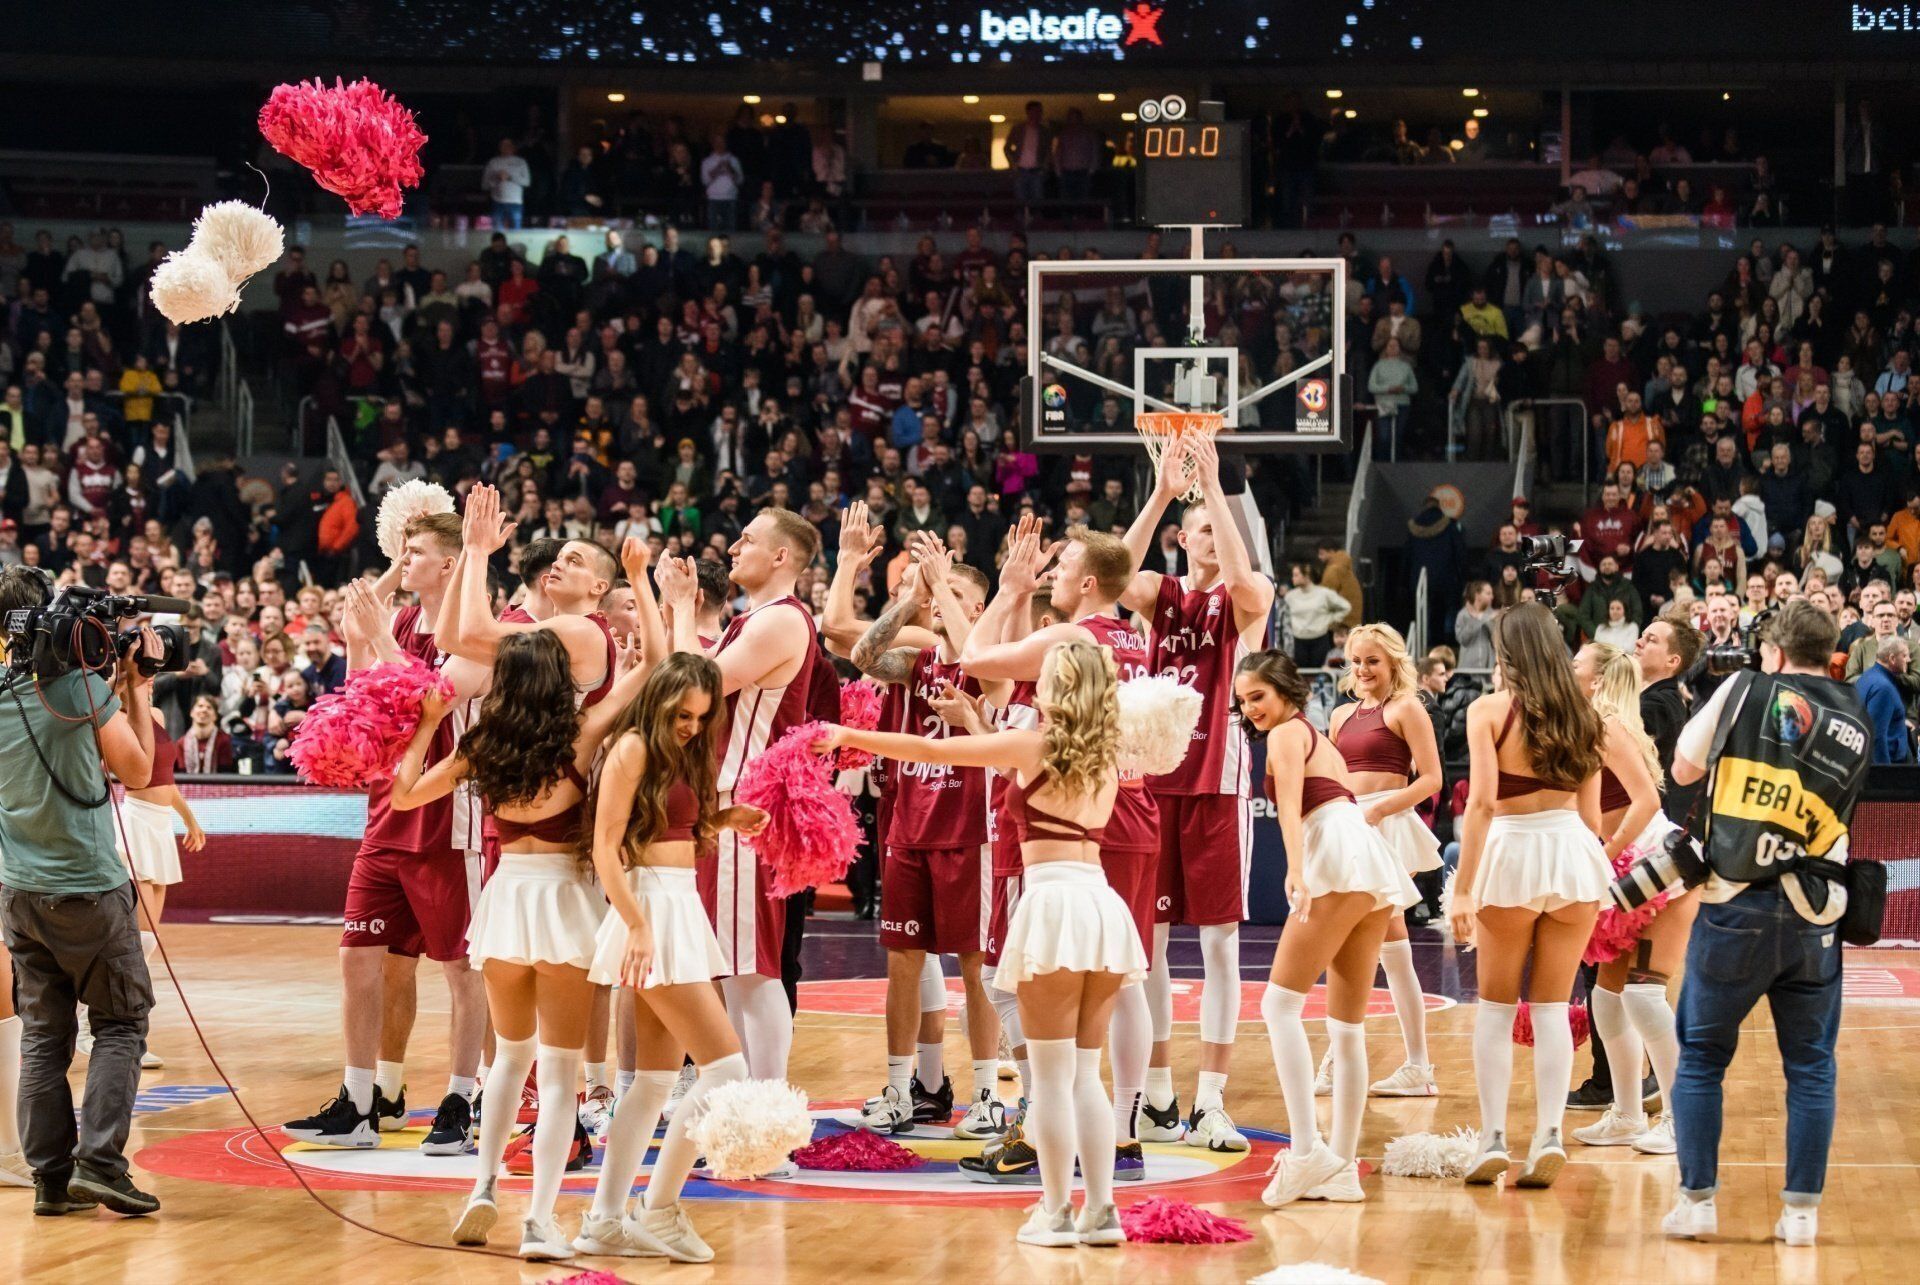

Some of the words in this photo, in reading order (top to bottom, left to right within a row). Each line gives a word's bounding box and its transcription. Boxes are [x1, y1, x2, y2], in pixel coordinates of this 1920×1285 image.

[980, 8, 1123, 41] betsafe
[1852, 4, 1920, 31] bet
[1145, 127, 1219, 157] 00.0
[1045, 410, 1065, 421] FIBA
[1826, 717, 1865, 755] FIBA
[948, 779, 963, 788] Bar
[1741, 776, 1792, 812] FBA
[369, 919, 385, 934] K
[904, 920, 920, 936] K
